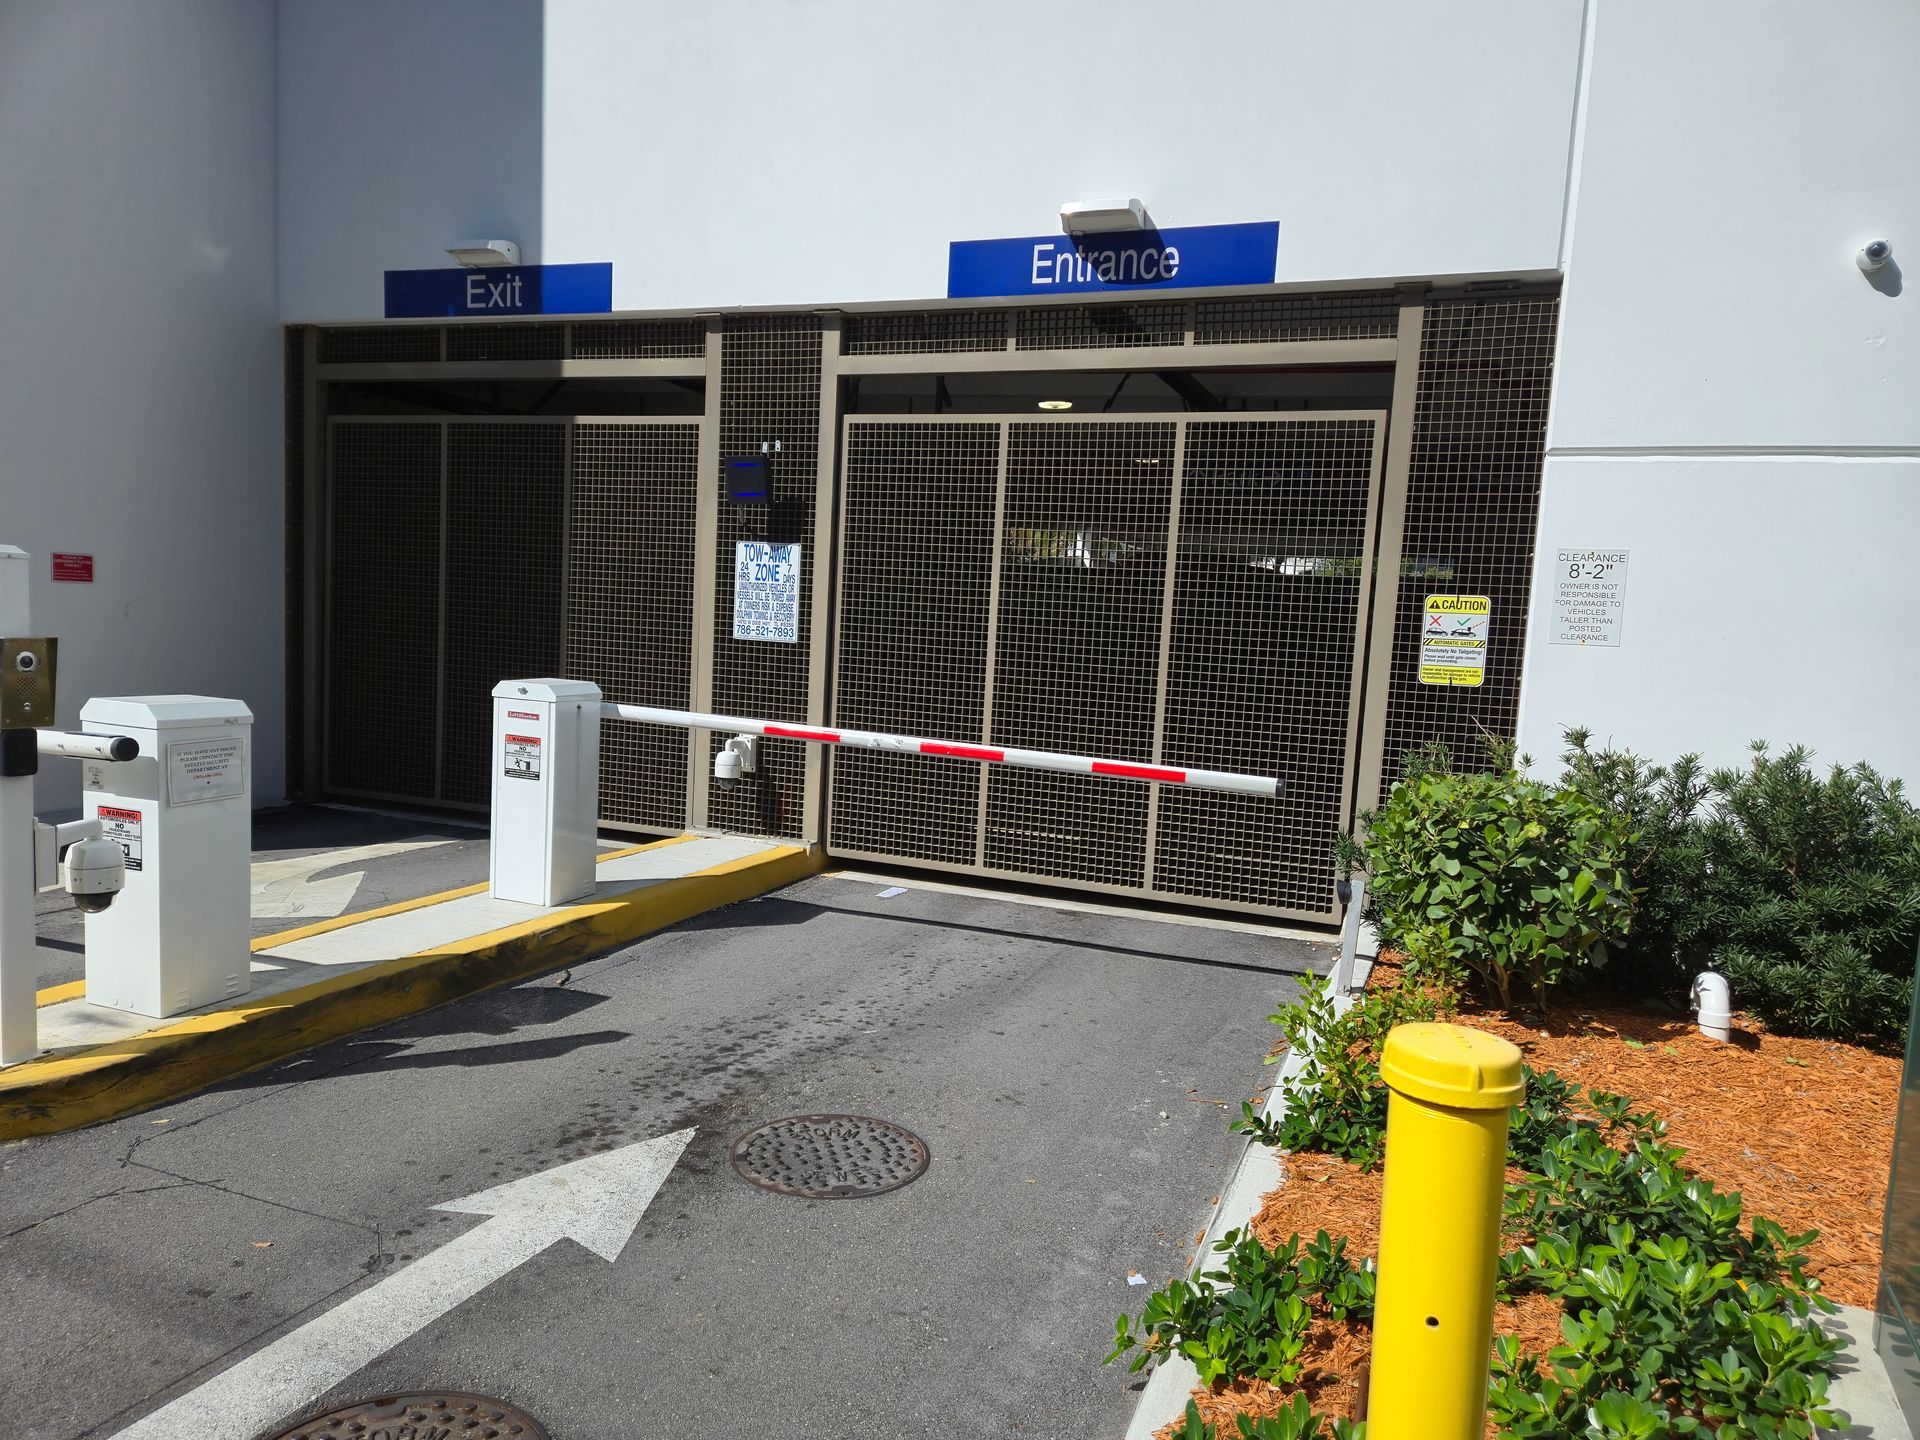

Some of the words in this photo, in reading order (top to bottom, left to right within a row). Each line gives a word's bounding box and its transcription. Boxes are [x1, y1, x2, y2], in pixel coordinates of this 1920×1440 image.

[1032, 244, 1180, 284] Entrance
[466, 274, 522, 308] Exit
[744, 544, 792, 563] TOW-AWAY
[1558, 553, 1626, 562] CLEARANCE
[741, 562, 749, 571] 24
[787, 564, 792, 573] 7
[1569, 563, 1613, 579] 8'-2"
[739, 572, 750, 582] HRS
[755, 563, 780, 582] ZONE
[783, 574, 796, 584] DAYS
[739, 582, 767, 591] UNAUTHORIZED
[769, 583, 787, 592] VEHICLES
[788, 584, 794, 593] OR
[737, 591, 753, 600] VESSELS
[755, 592, 763, 601] WILL
[765, 592, 770, 601] BE
[771, 593, 784, 602] TOWED
[786, 593, 796, 602] AWAY
[739, 601, 743, 609] AT
[761, 602, 770, 611] RISK
[772, 602, 774, 611] &
[776, 603, 794, 612] EXPENSE
[1442, 600, 1487, 611] CAUTION
[737, 610, 752, 619] DOLPHIN
[754, 611, 768, 620] TOWING
[774, 612, 795, 622] RECOVERY
[736, 625, 794, 637] 786-521-7893
[106, 809, 137, 819] WARNING!
